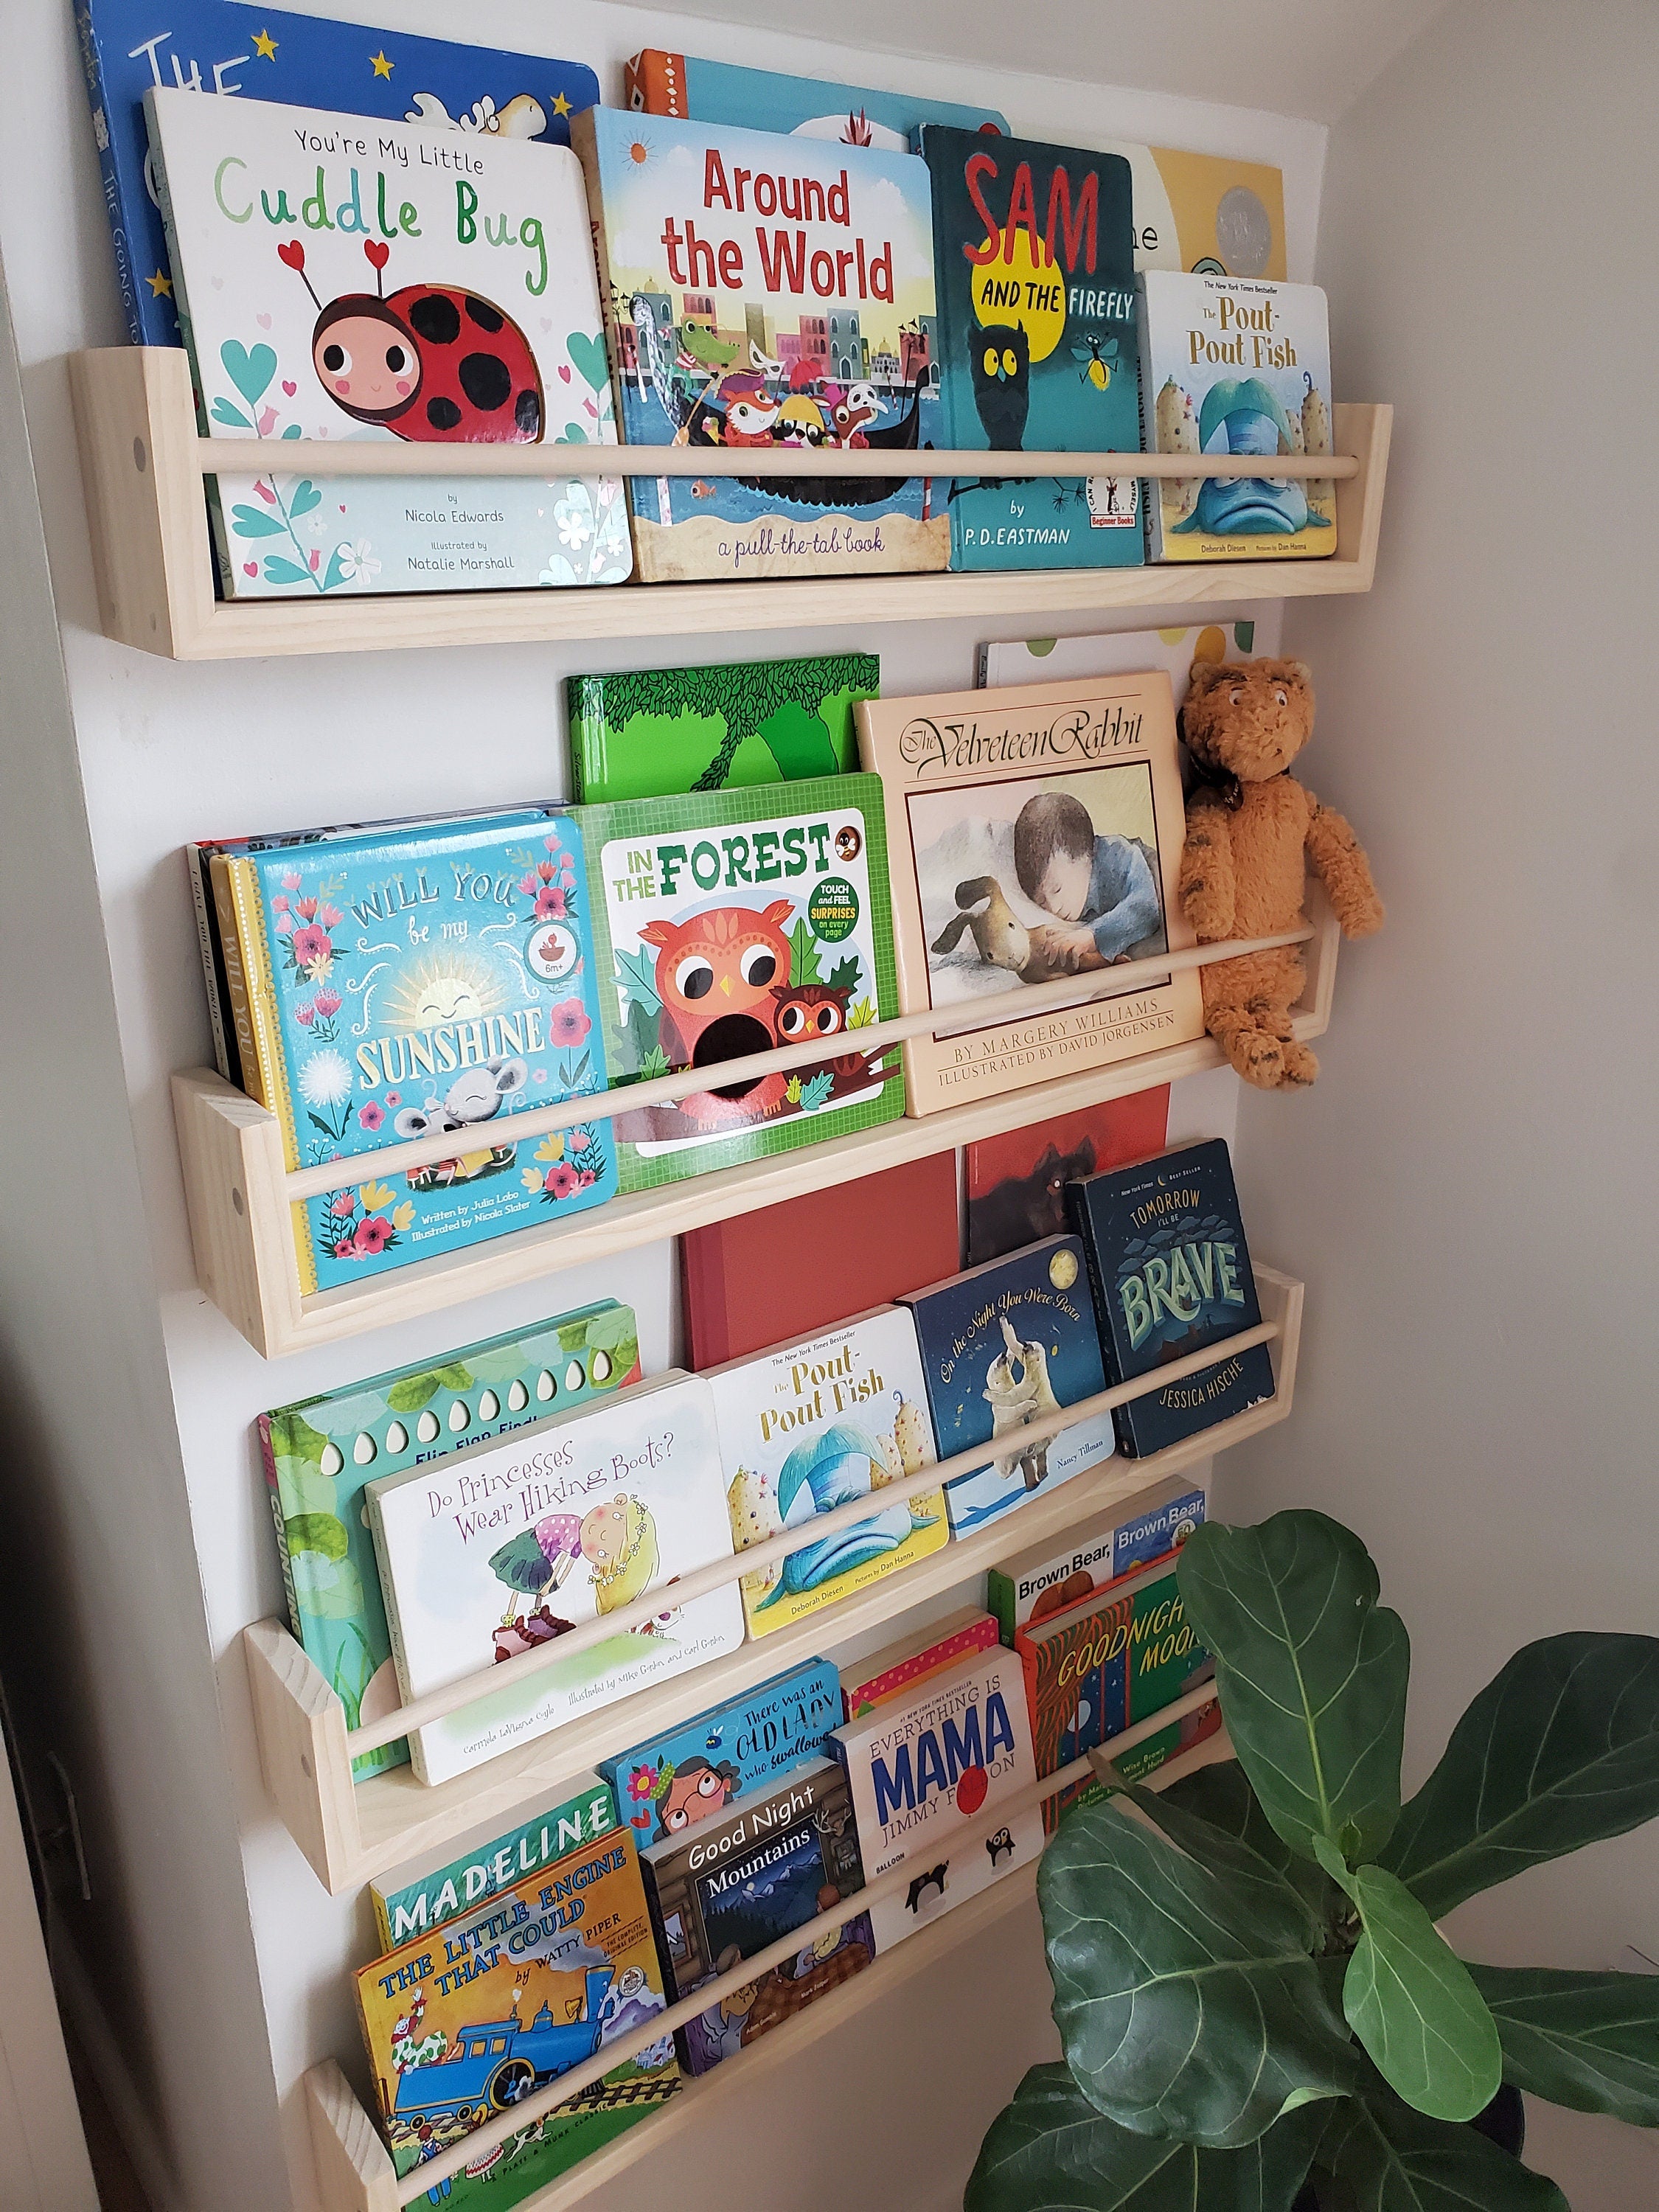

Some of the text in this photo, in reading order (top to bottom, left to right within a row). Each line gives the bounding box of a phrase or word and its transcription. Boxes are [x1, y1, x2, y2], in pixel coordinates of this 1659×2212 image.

[128, 30, 252, 95] THE
[293, 129, 485, 175] You're My Little
[703, 148, 851, 227] Around
[213, 156, 549, 296] Cuddle Bug
[961, 153, 1099, 275] SAM
[661, 216, 894, 304] the World
[981, 278, 1133, 319] AND THE FIREFLY
[1204, 280, 1278, 294] The New York Times Bestseller
[1203, 296, 1280, 333] The Pout-
[1186, 330, 1298, 369] Pout Fish
[406, 509, 504, 523] Nicola Edwards
[448, 493, 458, 504] by
[1010, 500, 1024, 518] by
[1092, 517, 1133, 526] Beginner Books
[408, 556, 515, 570] Natalie Marshall
[431, 541, 487, 552] Illustrated by
[718, 526, 885, 568] a pull-the-tab book
[1201, 543, 1307, 553] Deborah Diesen Dan Hanna
[905, 718, 1047, 777] Velveteen
[1049, 706, 1144, 759] Rabbit
[627, 822, 831, 896] IN FOREST
[350, 871, 516, 930] WILL YOU
[612, 874, 656, 902] THE
[818, 895, 850, 905] and FEEL
[821, 885, 849, 894] TOUCH
[407, 915, 469, 946] be my
[811, 907, 855, 919] SURPRISES
[825, 929, 842, 938] page
[829, 921, 849, 929] every
[544, 961, 564, 974] 6m+
[224, 936, 254, 1056] WILL YOU
[355, 1007, 547, 1091] SUNSHINE
[939, 1014, 1175, 1087] ILLUSTRATED BY DAVID JORGENSEN
[953, 998, 1159, 1064] BY MARGERY WILLIAMS
[411, 1200, 532, 1243] Illustrated by Nicola Slater
[421, 1190, 520, 1225] Written by Julia Lobo
[1130, 1189, 1200, 1230] TOMORROW
[1157, 1214, 1180, 1227] I'LL BE
[1119, 1242, 1246, 1351] BRAVE
[771, 1330, 856, 1367] The New York Times Bestseller
[940, 1287, 1082, 1383] On the Night You Were Born
[787, 1345, 861, 1397] Pout-
[1159, 1387, 1206, 1409] JESSICA
[1206, 1357, 1244, 1400] HISCHE
[755, 1368, 886, 1444] Pout Fish
[1057, 1439, 1104, 1470] Nancy Tillman
[427, 1440, 574, 1518] Do Princesses
[452, 1432, 675, 1545] Wear Hiking Boots?
[271, 1494, 302, 1638] COUNTING
[1018, 1563, 1070, 1601] Brown
[1072, 1543, 1110, 1572] Bear,
[1118, 1516, 1166, 1550] Brown
[1168, 1498, 1204, 1525] Bear,
[791, 1551, 915, 1615] Deborah Diesen Pictures Dan Hanna
[1057, 1594, 1184, 1687] GOODNIGH
[568, 1682, 605, 1706] Illustrated
[743, 1680, 824, 1727] There was an
[919, 1680, 973, 1714] YORK TIMES BESTSELLER
[869, 1675, 1001, 1759] EVERYTHING IS
[736, 1721, 777, 1761] OLD
[871, 1691, 1015, 1826] MAMA
[1123, 1747, 1165, 1773] Wise Brown
[744, 1761, 768, 1781] who
[688, 1786, 815, 1871] Good Night
[883, 1797, 939, 1848] JIMMY
[394, 1795, 613, 1939] MADELINE
[706, 1829, 812, 1899] Mountains
[876, 1852, 905, 1874] BALLOON
[378, 1955, 435, 1998] THE
[444, 1902, 530, 1965] LITTLE
[538, 1846, 627, 1911] ENGINE
[603, 1928, 648, 1958] ORIGINAL EDITION
[607, 1938, 616, 1947] THE
[434, 1898, 585, 1997] THAT COULD
[515, 1913, 622, 1986] by WATTY PIPER
[544, 2128, 570, 2147] MUNK
